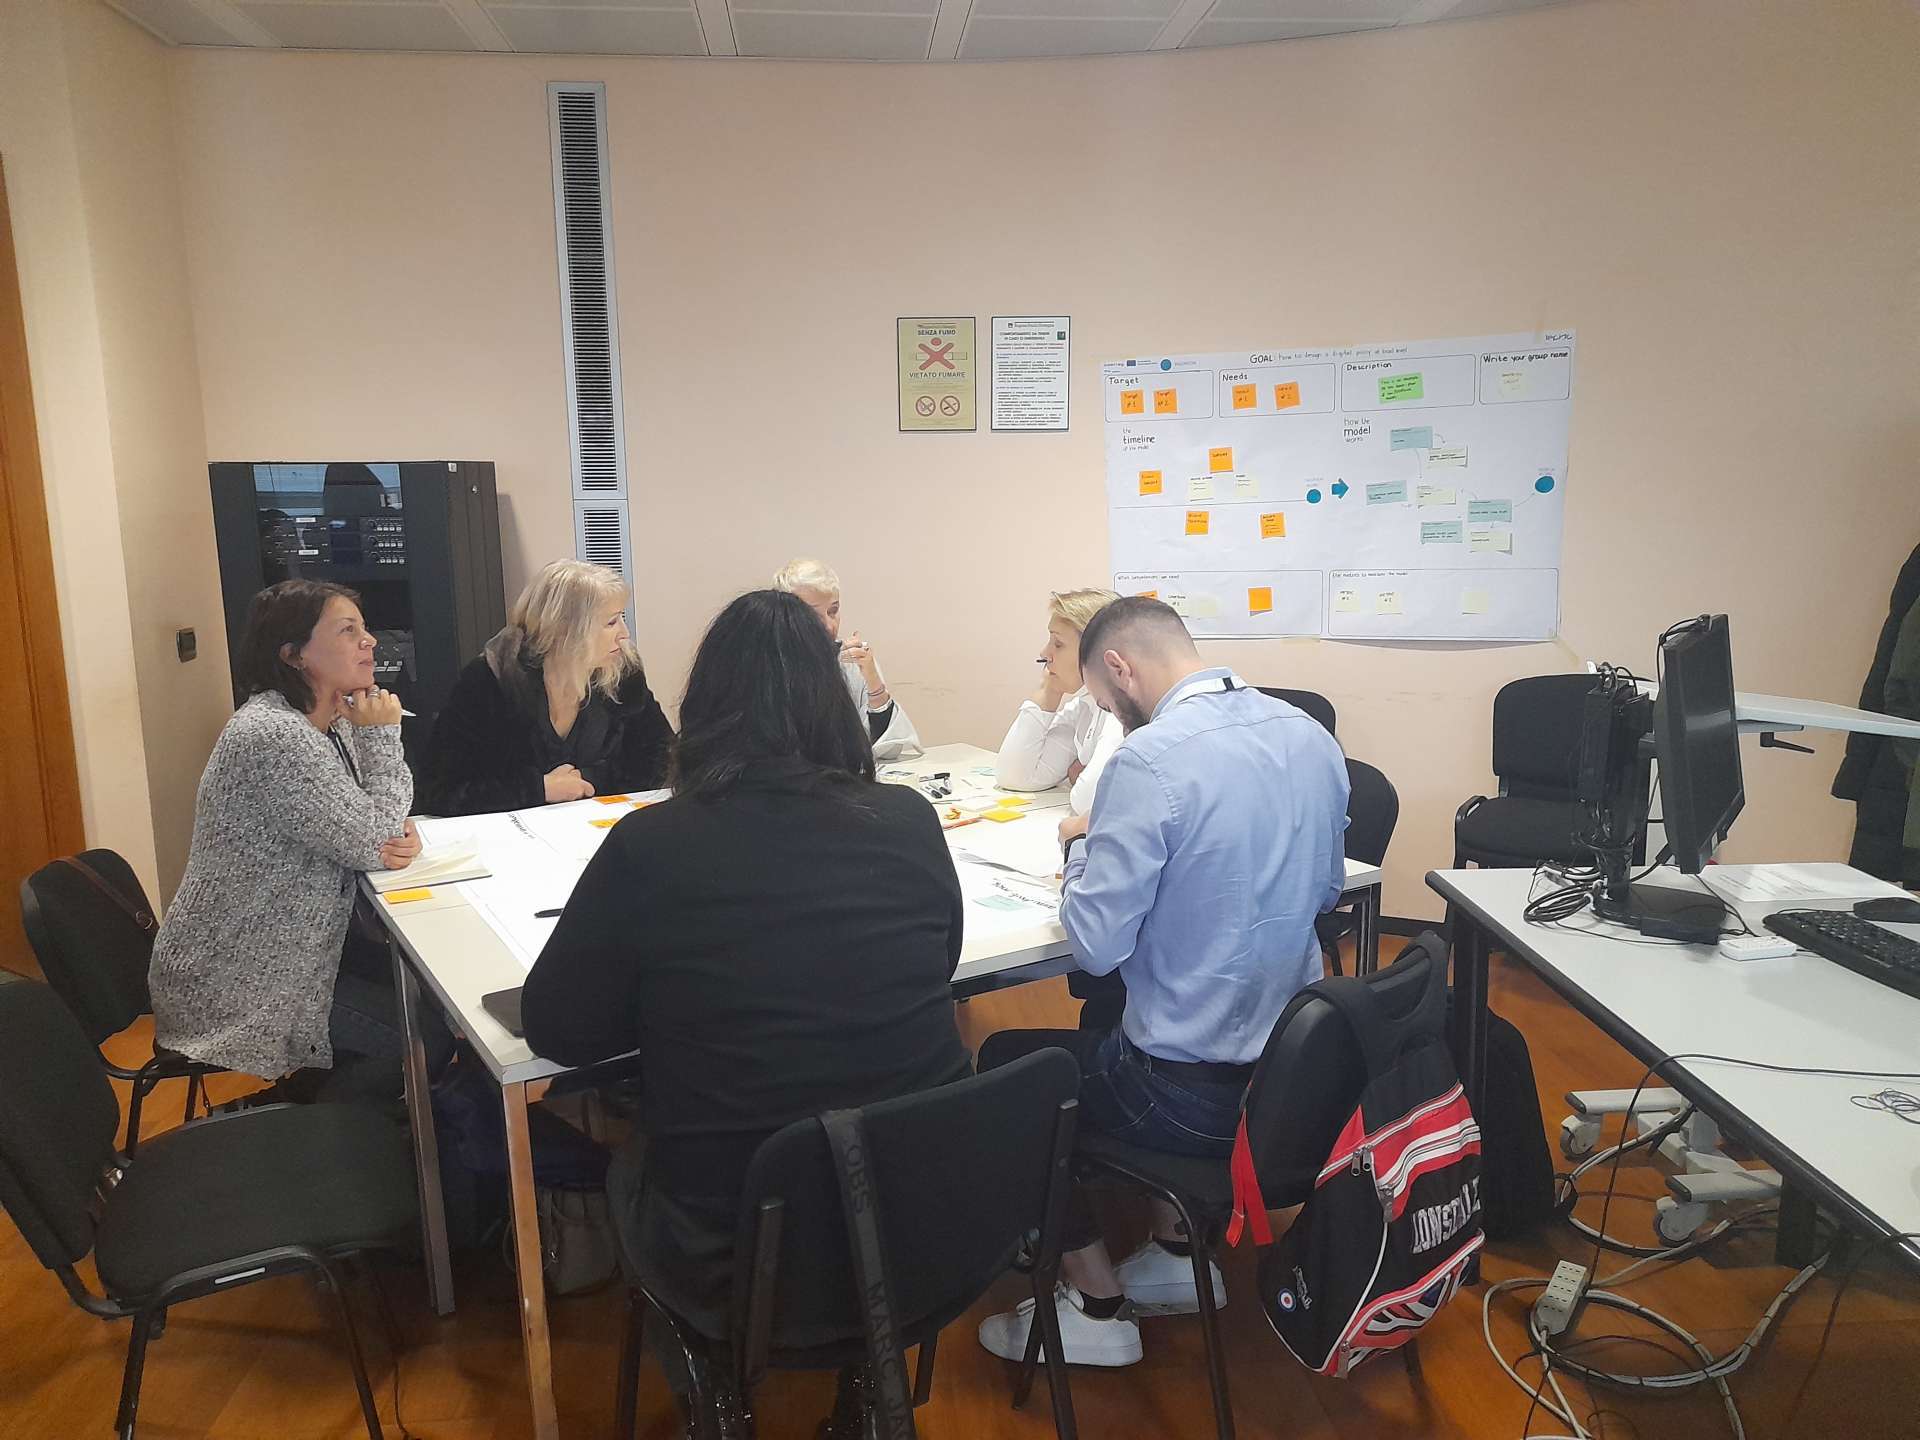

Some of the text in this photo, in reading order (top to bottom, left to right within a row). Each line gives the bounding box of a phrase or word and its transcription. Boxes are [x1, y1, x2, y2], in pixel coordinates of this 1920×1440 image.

[1483, 354, 1508, 363] Write
[1510, 354, 1525, 364] your
[1527, 353, 1548, 363] group
[1346, 361, 1392, 371] Description
[938, 371, 966, 379] FUMARE
[1222, 373, 1248, 381] Needs
[1109, 376, 1140, 386] Target
[1343, 425, 1371, 437] model
[1123, 434, 1156, 445] timeline
